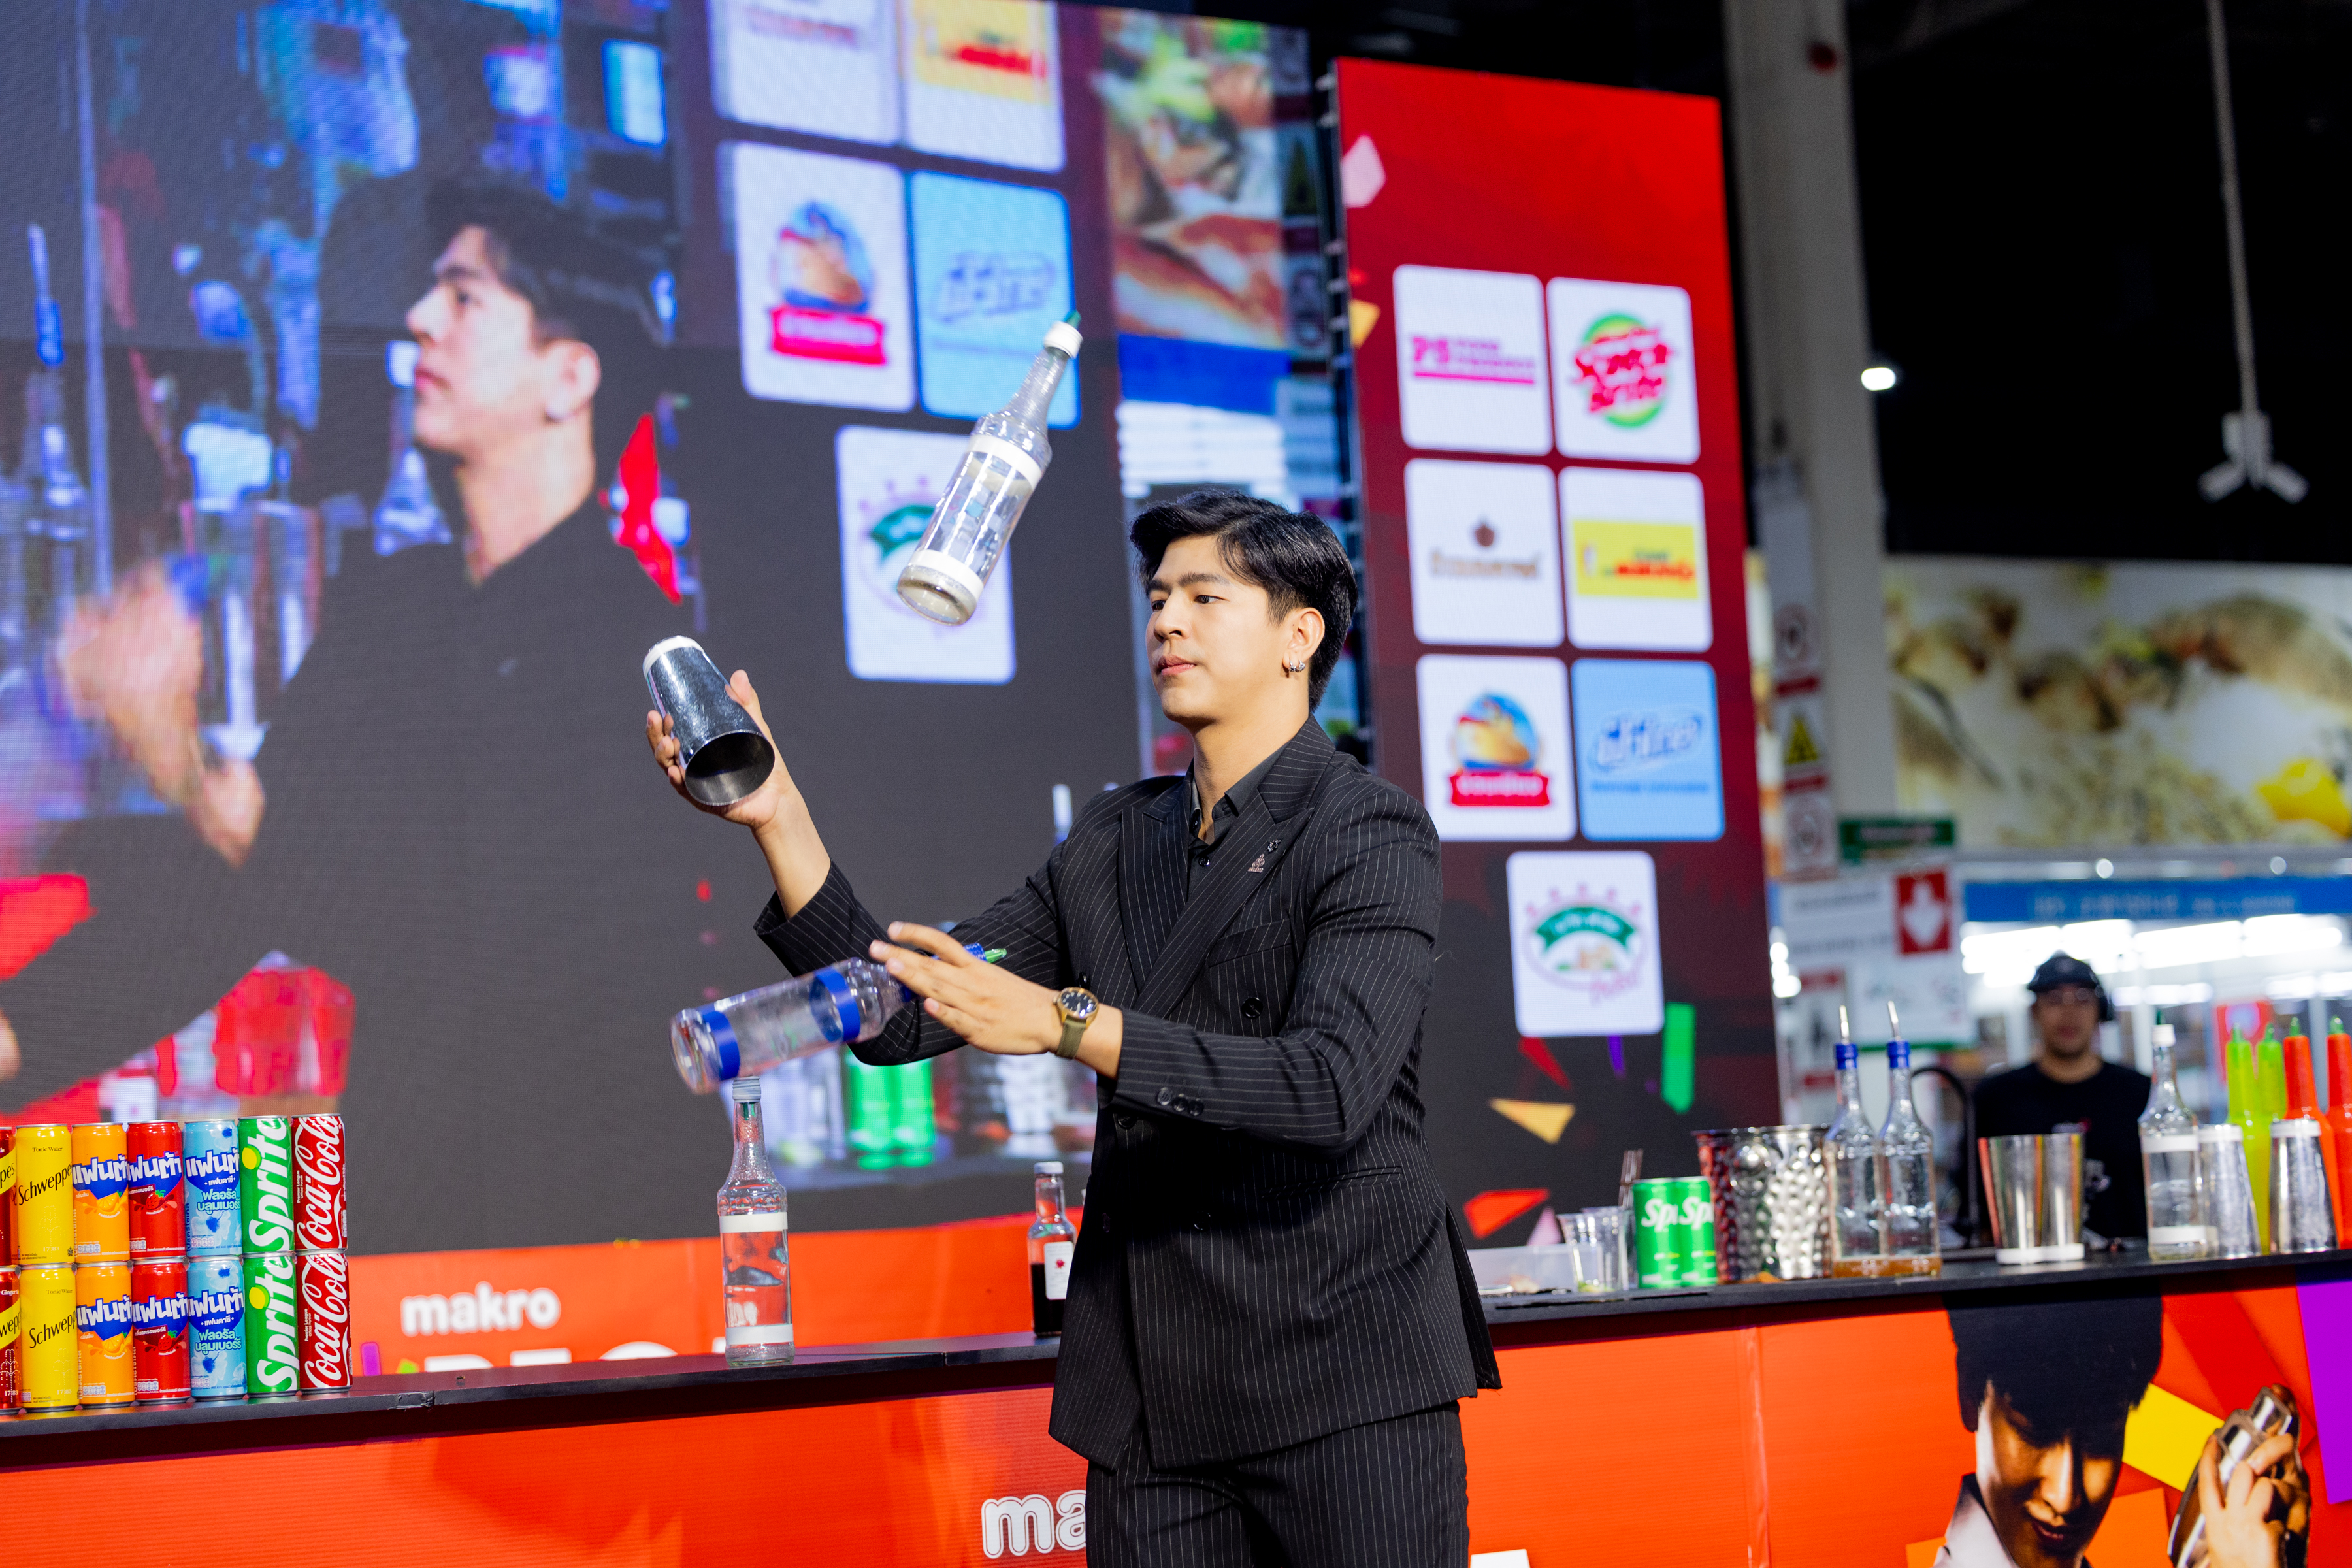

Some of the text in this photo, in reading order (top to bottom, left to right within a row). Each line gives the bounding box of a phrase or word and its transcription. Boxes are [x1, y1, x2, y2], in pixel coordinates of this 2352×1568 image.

[202, 1188, 237, 1201] ฟลอรัล
[247, 1117, 294, 1251] Sprite
[199, 1328, 236, 1341] ฟลอรัล
[255, 1256, 301, 1392] Sprite
[400, 1281, 563, 1337] makro
